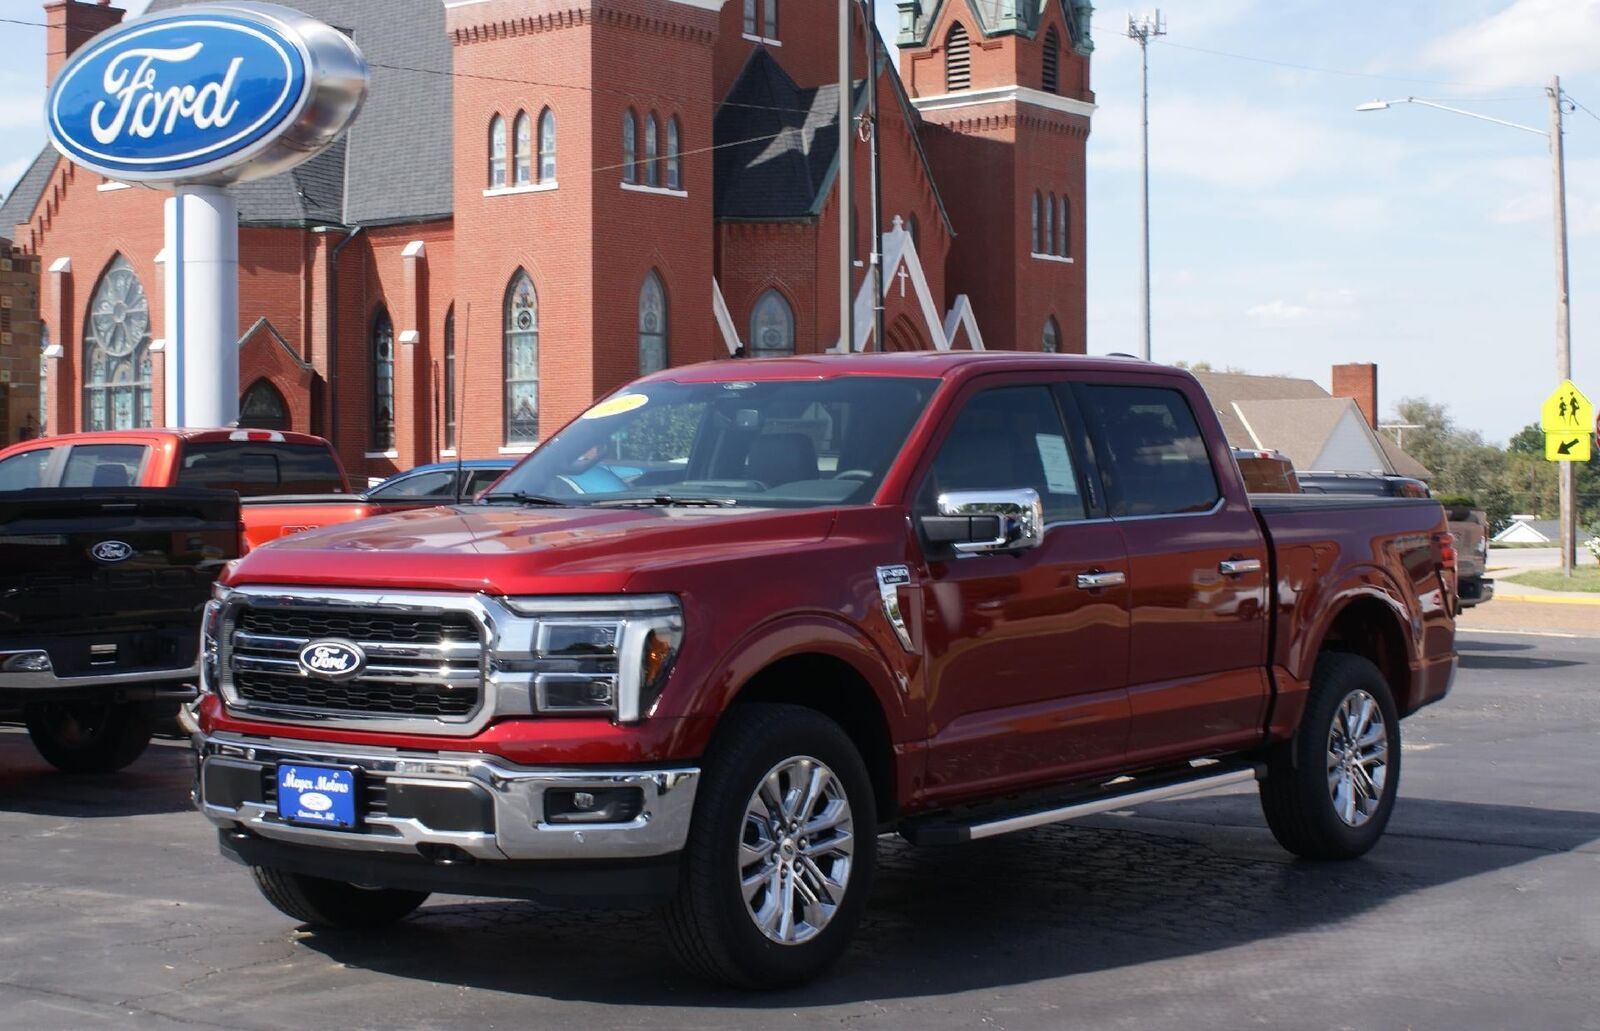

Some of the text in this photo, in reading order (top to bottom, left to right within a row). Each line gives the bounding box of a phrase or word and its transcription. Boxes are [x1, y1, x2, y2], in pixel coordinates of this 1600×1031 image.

[90, 42, 244, 144] Ford
[99, 543, 126, 558] Ford
[311, 646, 349, 670] Ford
